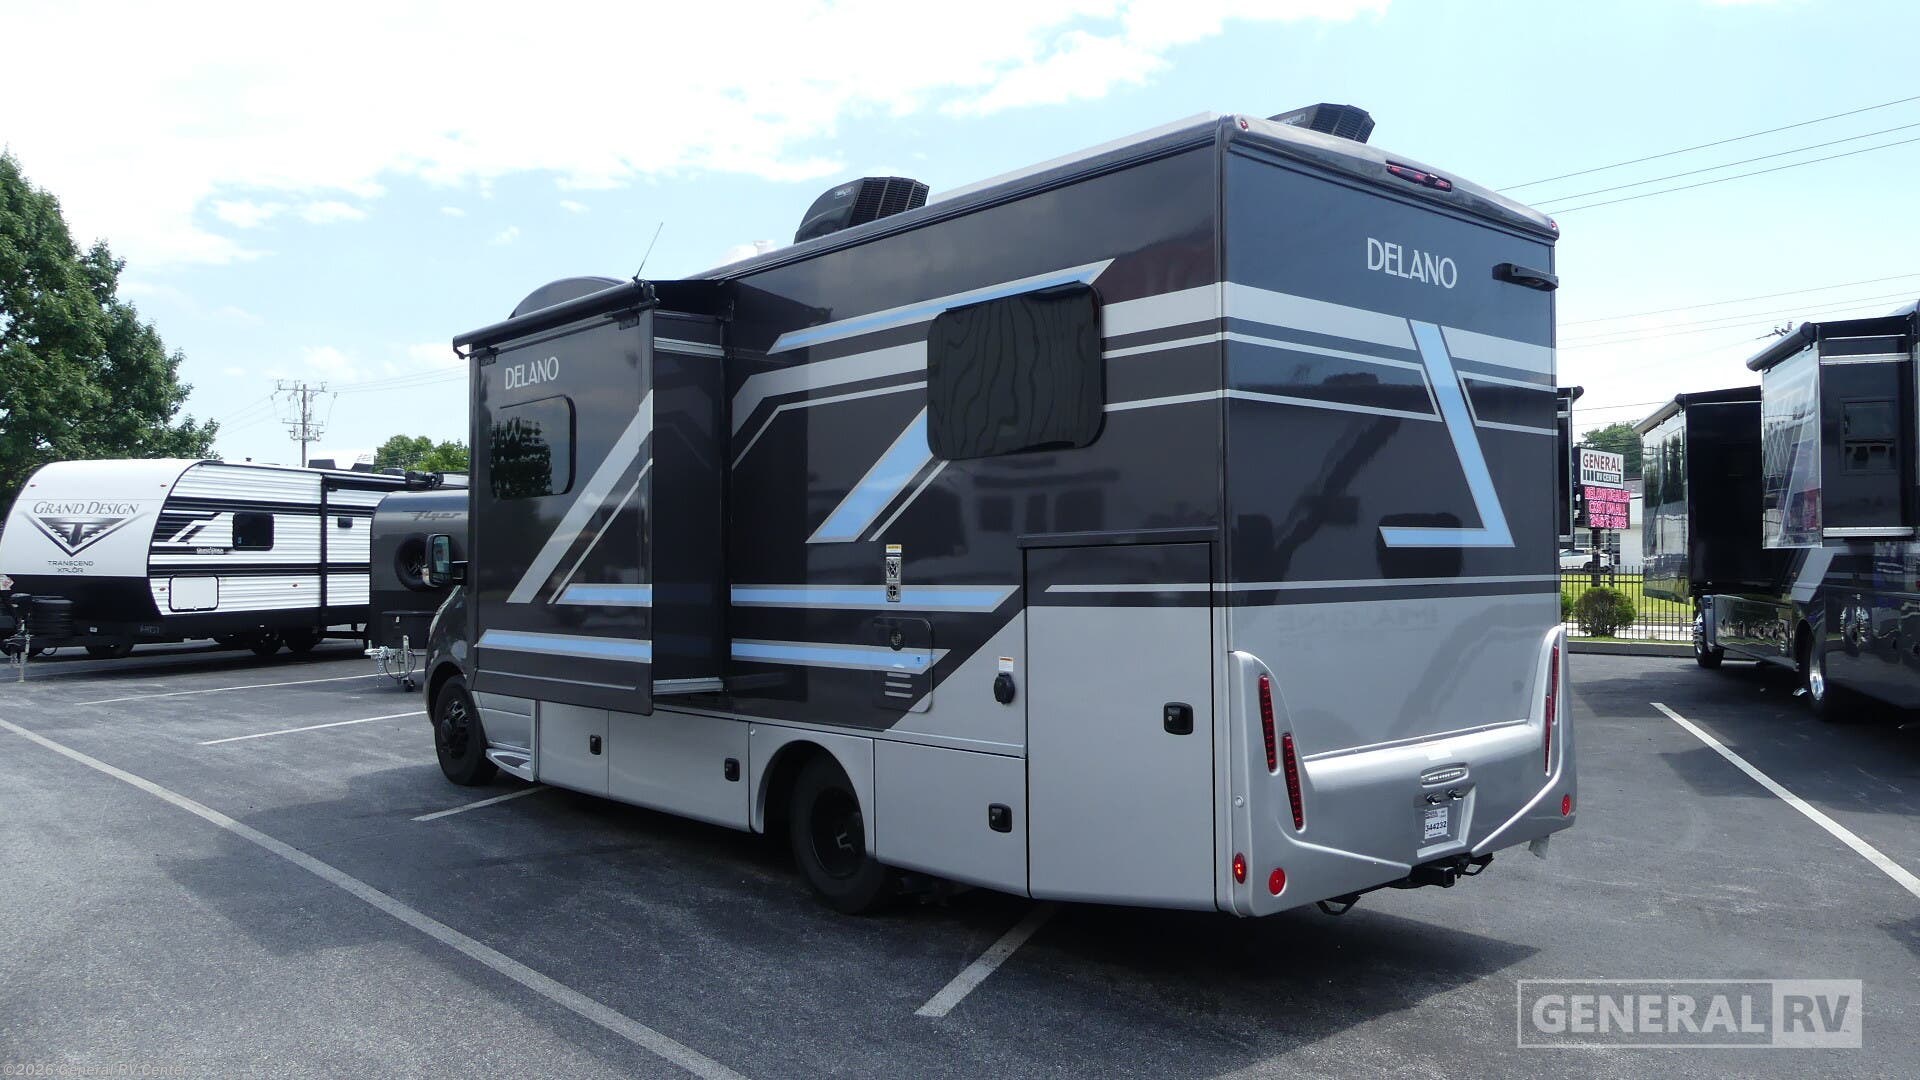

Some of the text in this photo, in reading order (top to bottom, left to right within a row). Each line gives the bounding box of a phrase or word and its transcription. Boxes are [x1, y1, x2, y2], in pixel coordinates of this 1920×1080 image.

[1367, 237, 1457, 289] DELANO
[505, 356, 559, 390] DELANO
[1583, 453, 1621, 472] GENERAL
[1603, 473, 1620, 483] CENTER
[33, 501, 139, 515] GRAND DESIGN
